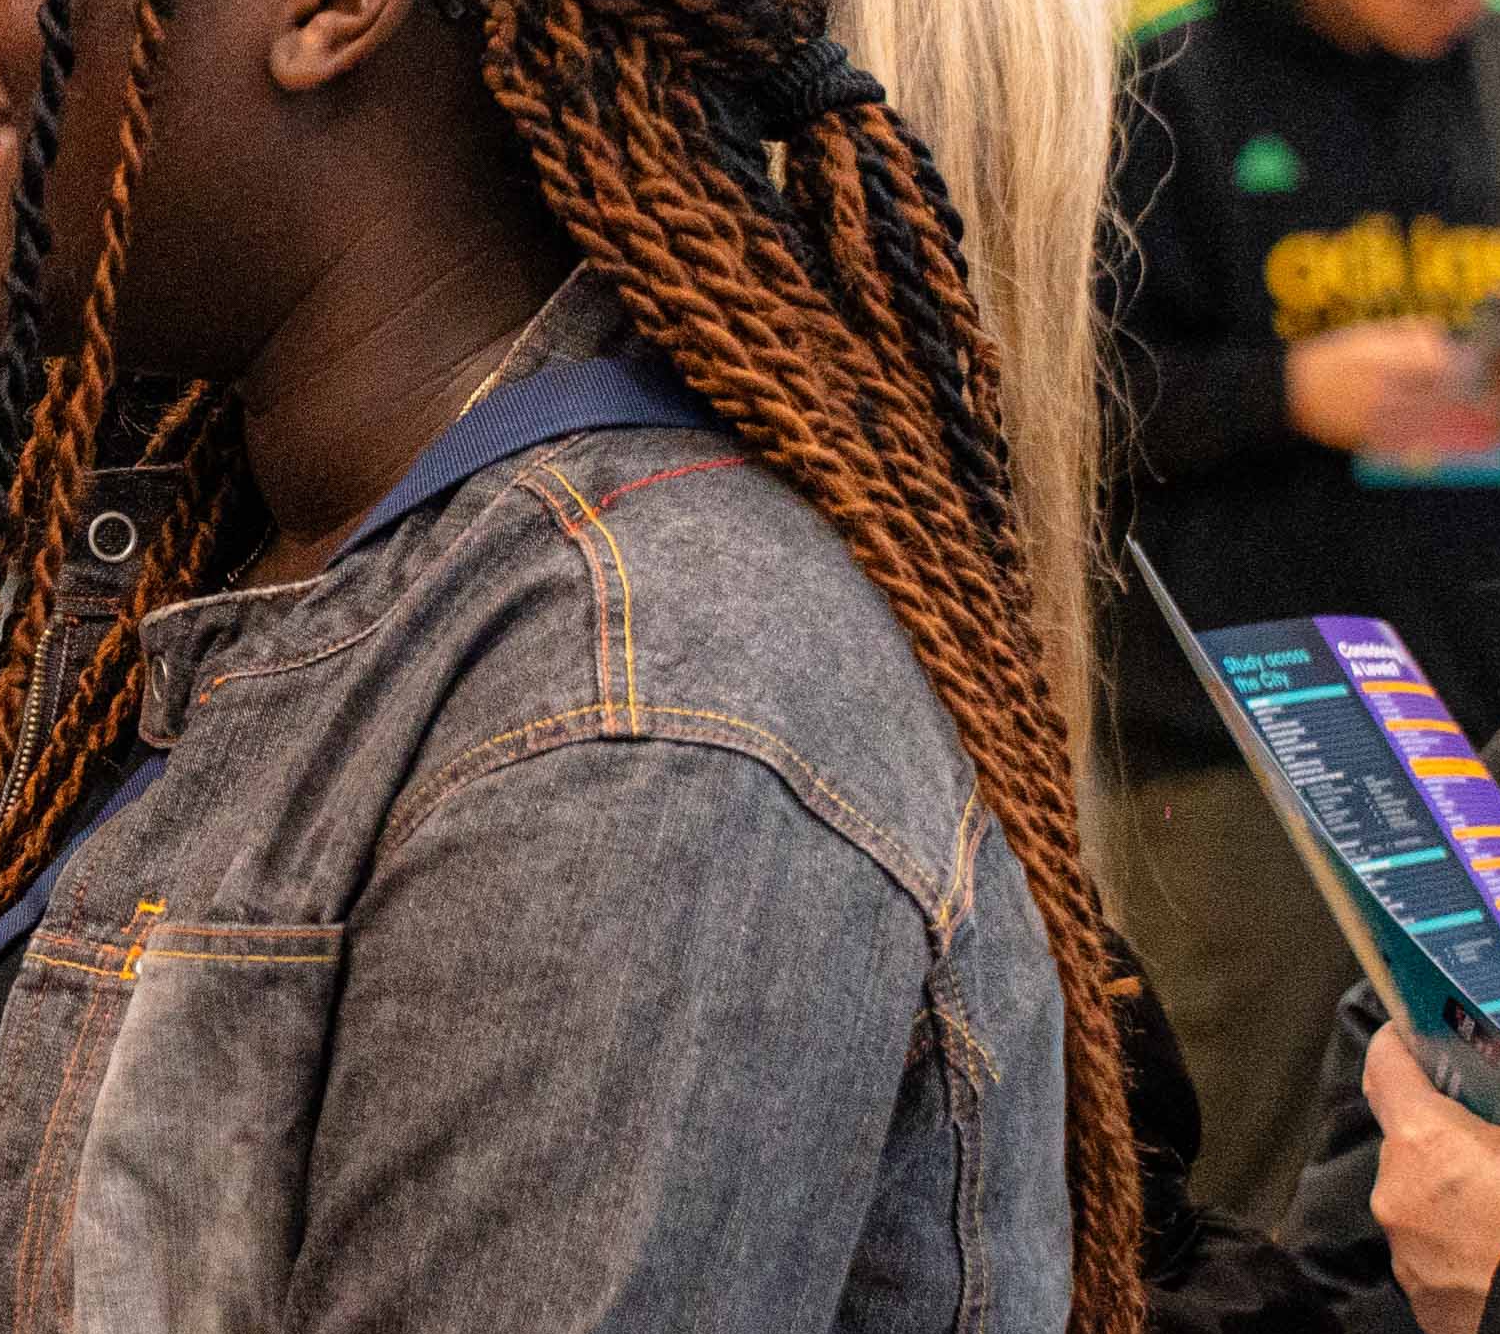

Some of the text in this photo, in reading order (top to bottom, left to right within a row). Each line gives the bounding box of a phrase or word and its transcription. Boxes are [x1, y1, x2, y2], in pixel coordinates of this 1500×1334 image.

[1222, 648, 1310, 675] Study across
[1233, 670, 1289, 694] the City
